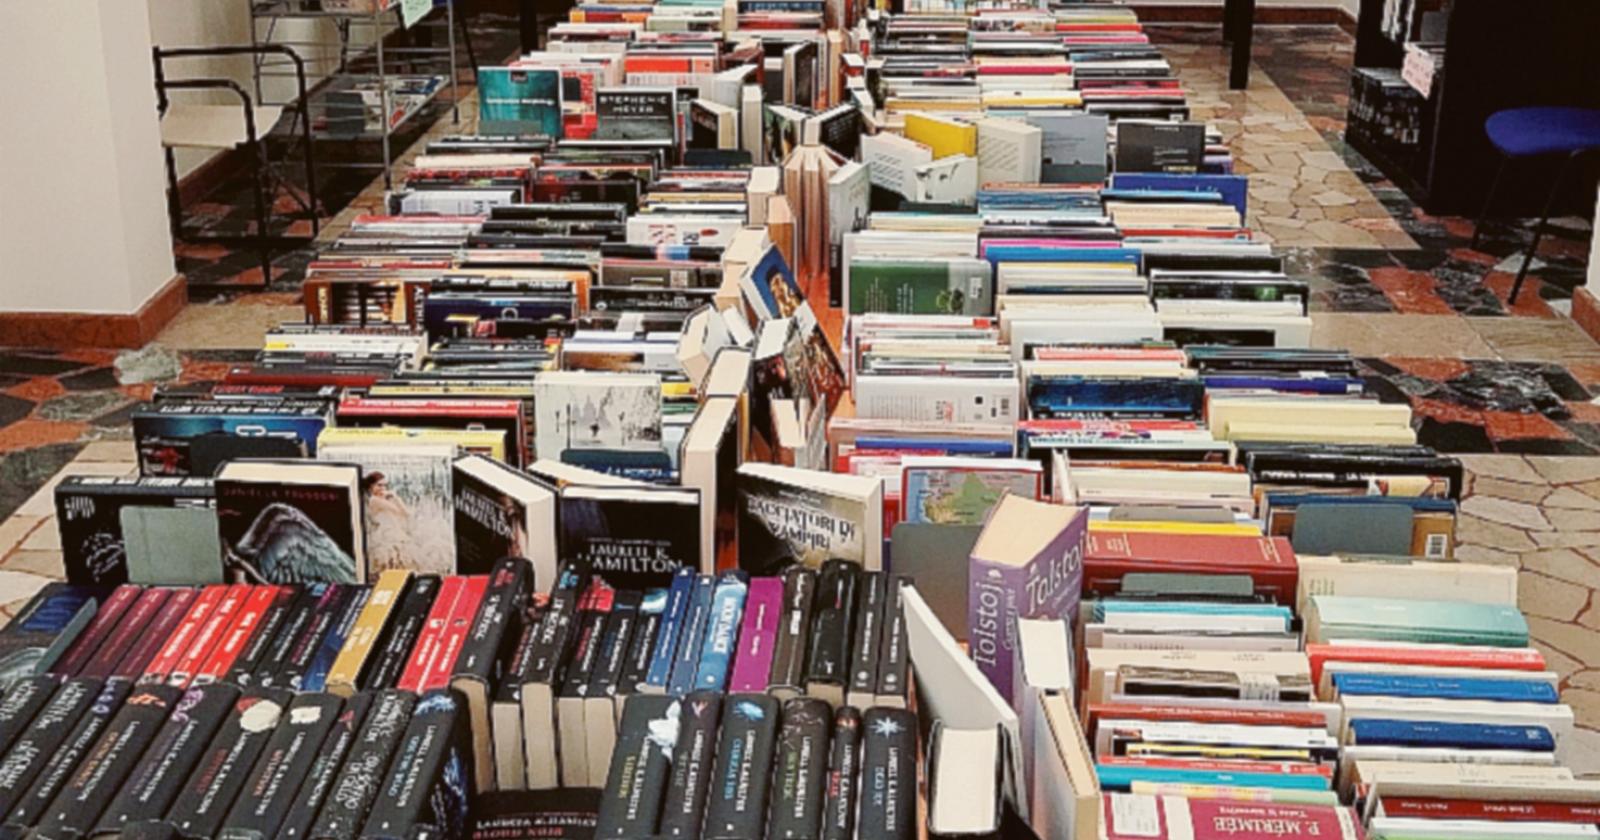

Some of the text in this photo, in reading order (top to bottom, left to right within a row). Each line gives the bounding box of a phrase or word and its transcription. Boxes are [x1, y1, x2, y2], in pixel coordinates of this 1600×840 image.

[1025, 530, 1085, 615] Tolstoj
[973, 580, 1004, 667] Tolstoj
[1213, 817, 1302, 837] MÉRIMÉE
